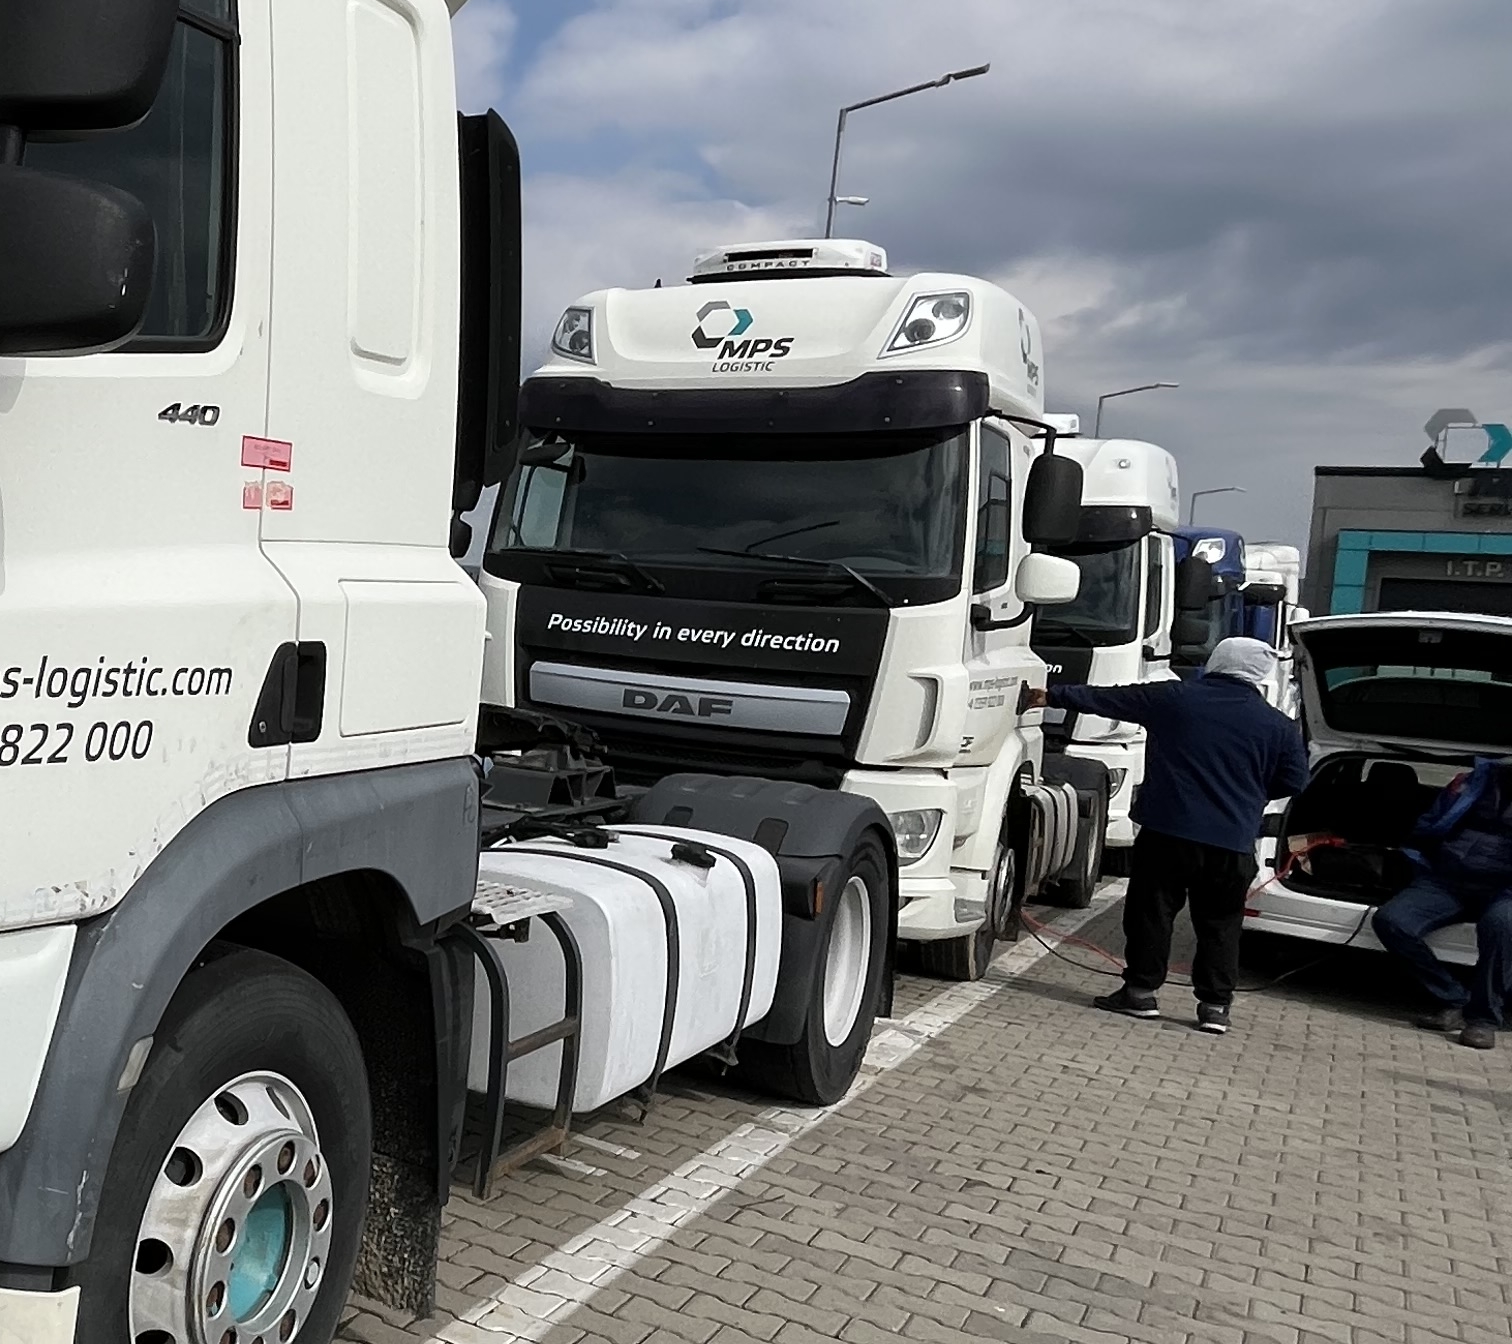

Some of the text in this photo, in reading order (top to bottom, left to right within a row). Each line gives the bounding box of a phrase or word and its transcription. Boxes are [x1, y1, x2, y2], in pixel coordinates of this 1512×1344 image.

[726, 259, 810, 272] COMPACT
[717, 337, 795, 360] MPS
[711, 361, 776, 373] LOGISTIC
[157, 402, 220, 426] 440
[1447, 560, 1504, 577] I.T.P.
[547, 613, 840, 654] Possibility in every direction
[622, 688, 734, 717] DAF
[85, 720, 154, 761] 000
